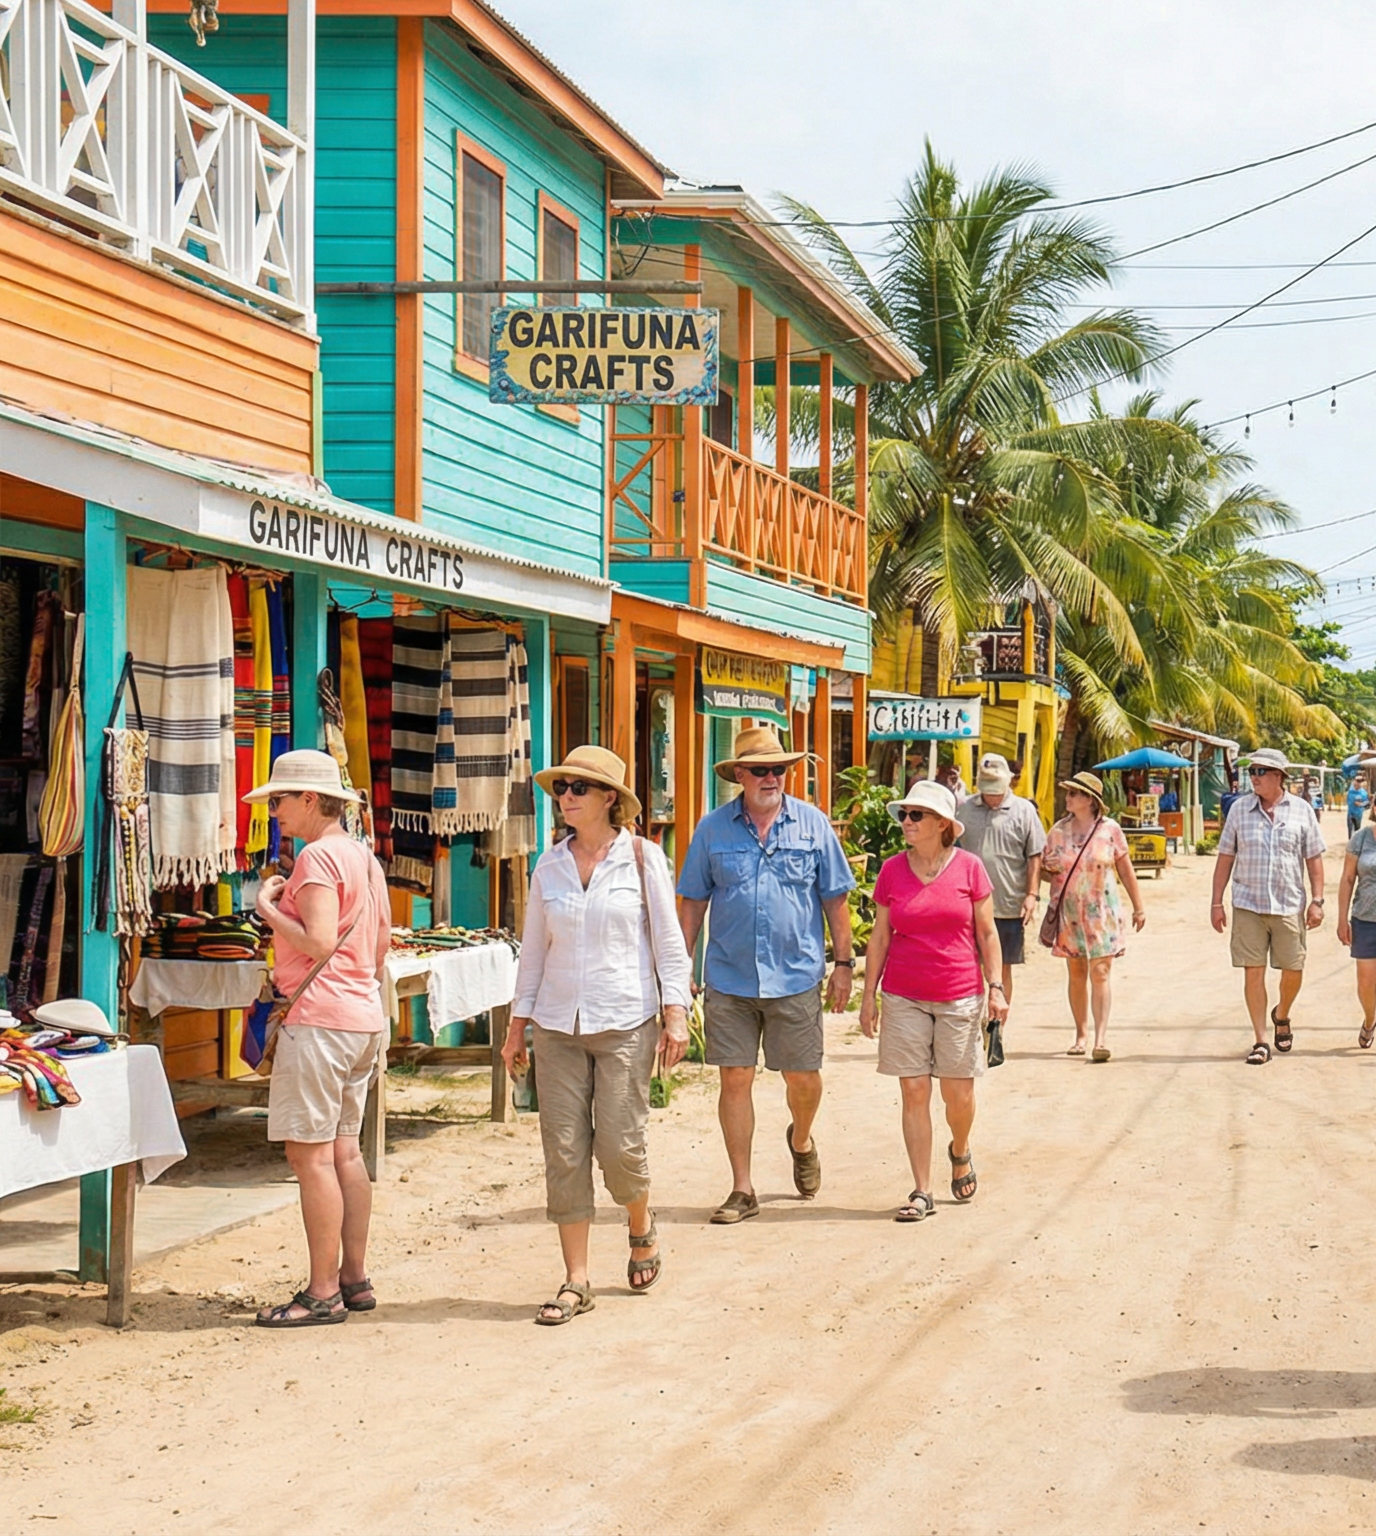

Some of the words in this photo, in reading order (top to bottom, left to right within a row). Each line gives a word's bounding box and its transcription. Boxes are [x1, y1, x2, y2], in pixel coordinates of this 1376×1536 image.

[508, 311, 701, 350] GARIFUNA
[529, 353, 675, 391] CRAFTS
[249, 500, 371, 570] GARIFUNA
[385, 536, 464, 590] CRAFTS
